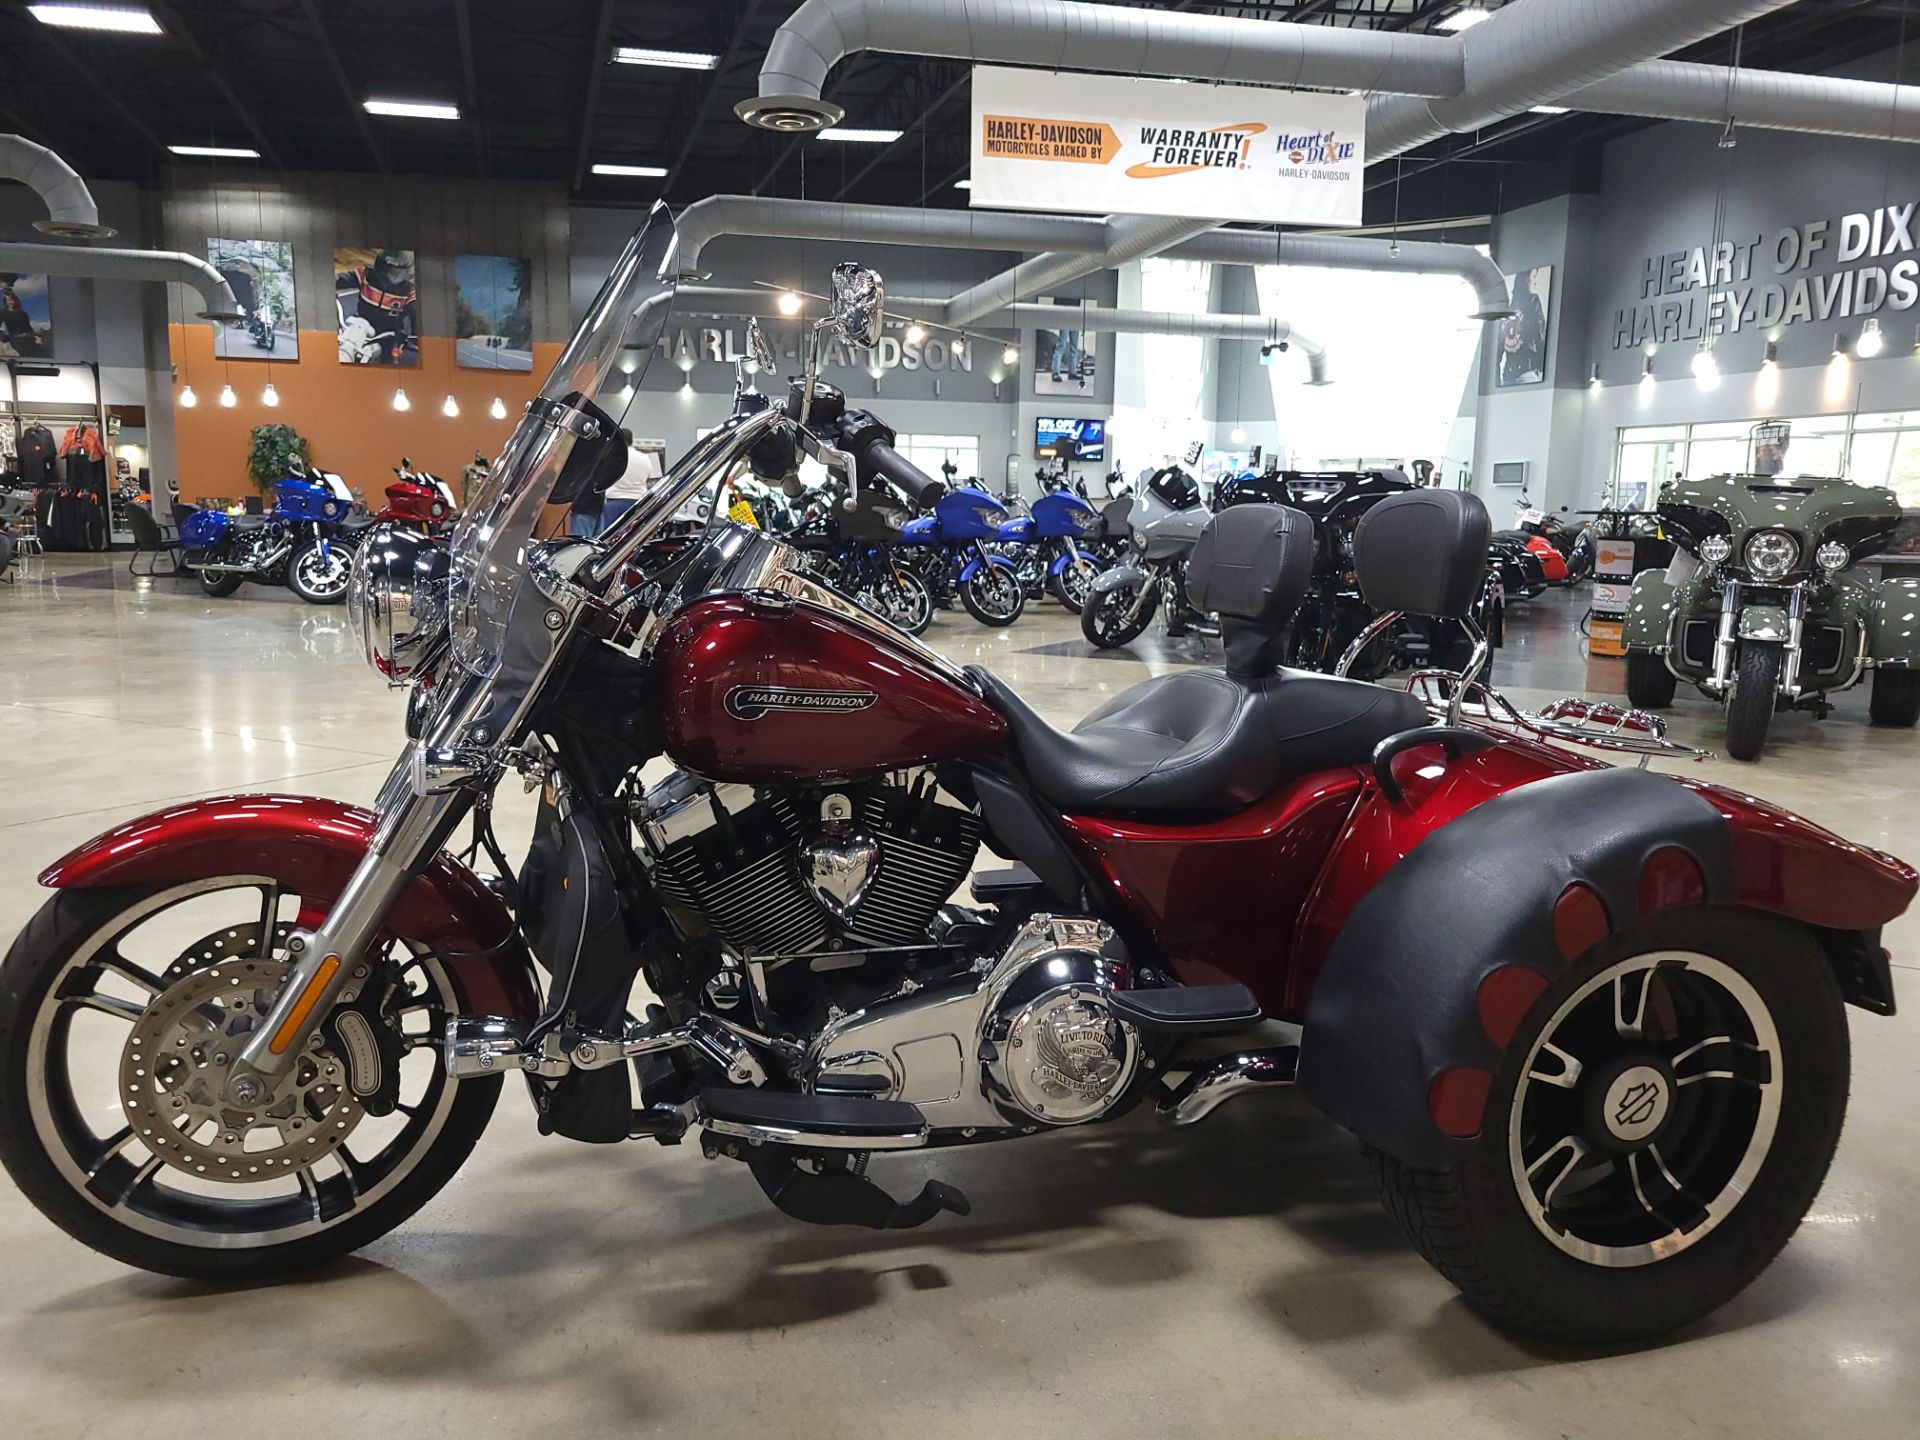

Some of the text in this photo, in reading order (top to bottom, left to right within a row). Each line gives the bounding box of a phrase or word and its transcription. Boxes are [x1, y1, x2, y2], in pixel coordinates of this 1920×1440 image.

[987, 120, 1102, 146] HARLEY-DAVIDSON
[1140, 127, 1244, 150] WARRANTY
[1276, 130, 1335, 152] Heart of
[987, 140, 1102, 159] MOTORCYCLES BACKED BY
[1306, 142, 1354, 165] DIXIE
[1278, 167, 1350, 181] HARLEY-DAVIDSON
[1640, 200, 1920, 299] HEART OF DIX
[747, 693, 867, 707] HARLEY-DAVIDSON
[1060, 1031, 1081, 1044] LIVE
[1081, 1030, 1093, 1041] TO
